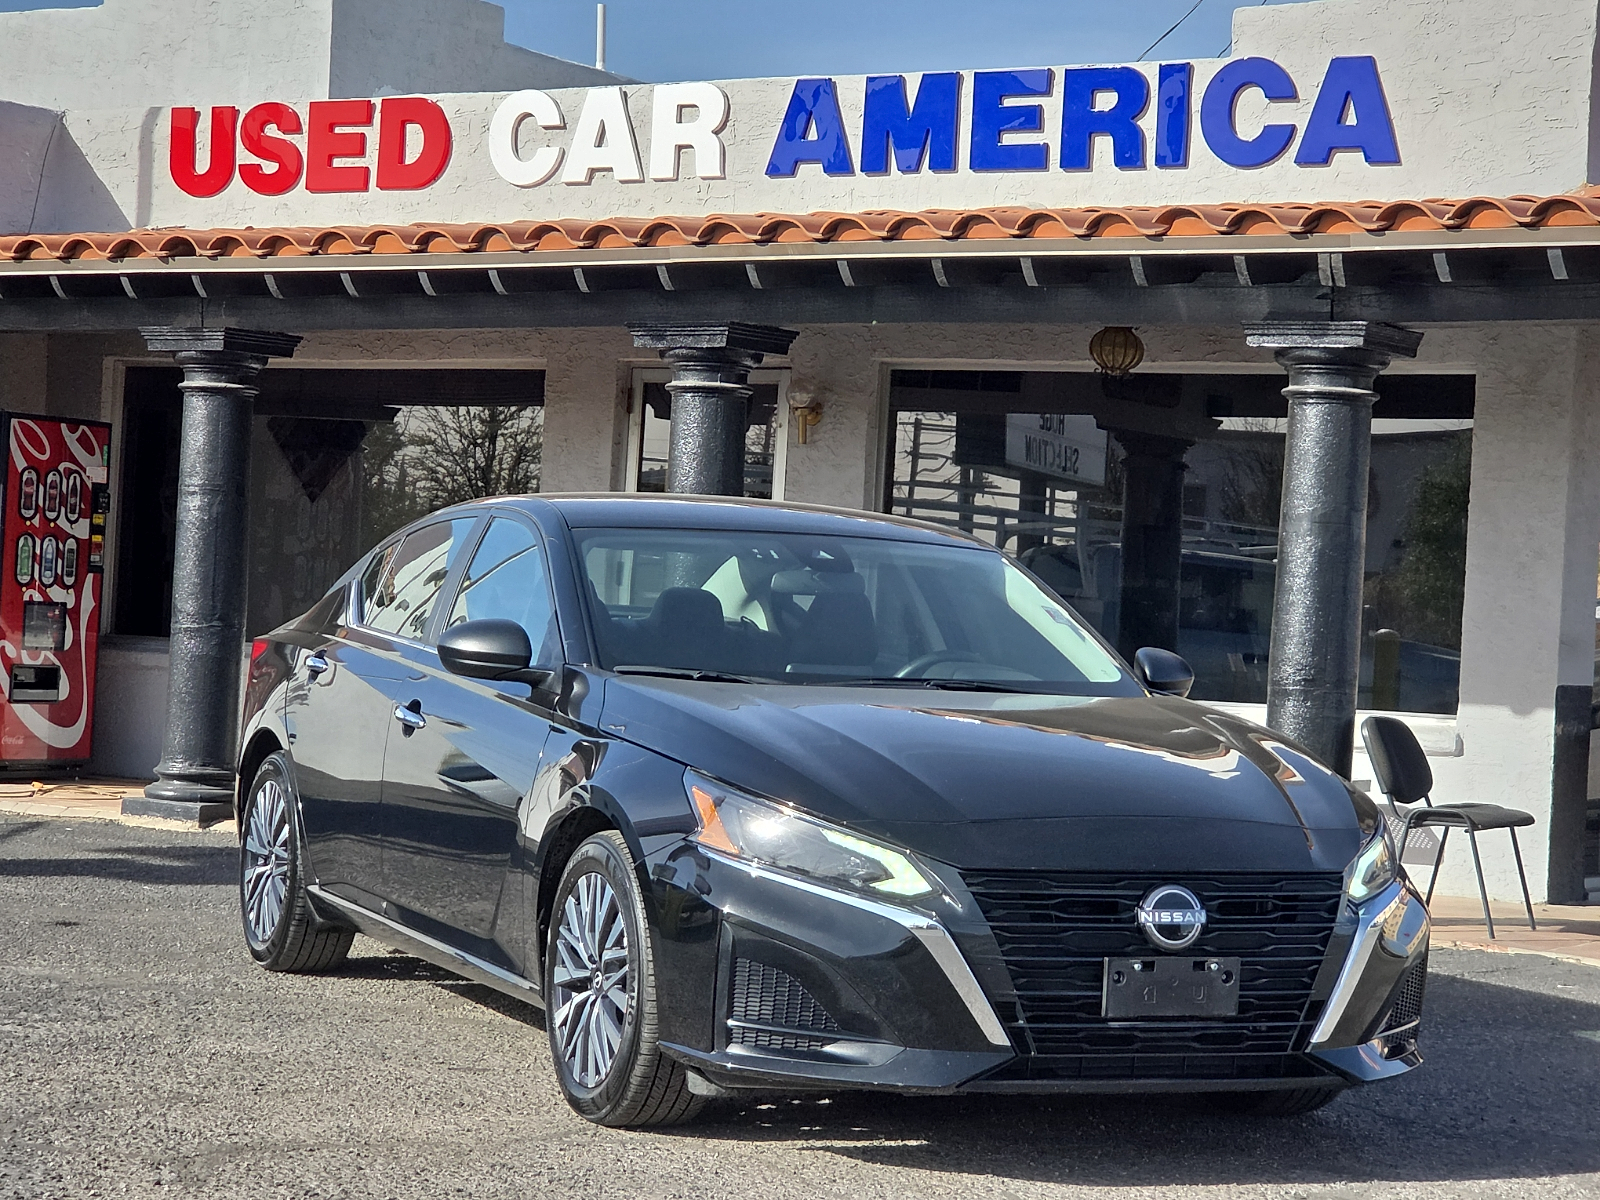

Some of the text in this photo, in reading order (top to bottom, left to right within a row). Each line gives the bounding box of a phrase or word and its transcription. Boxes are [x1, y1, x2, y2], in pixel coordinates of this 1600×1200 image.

[169, 55, 1403, 198] USED CAR AMERICA
[1140, 911, 1207, 922] NISSAN
